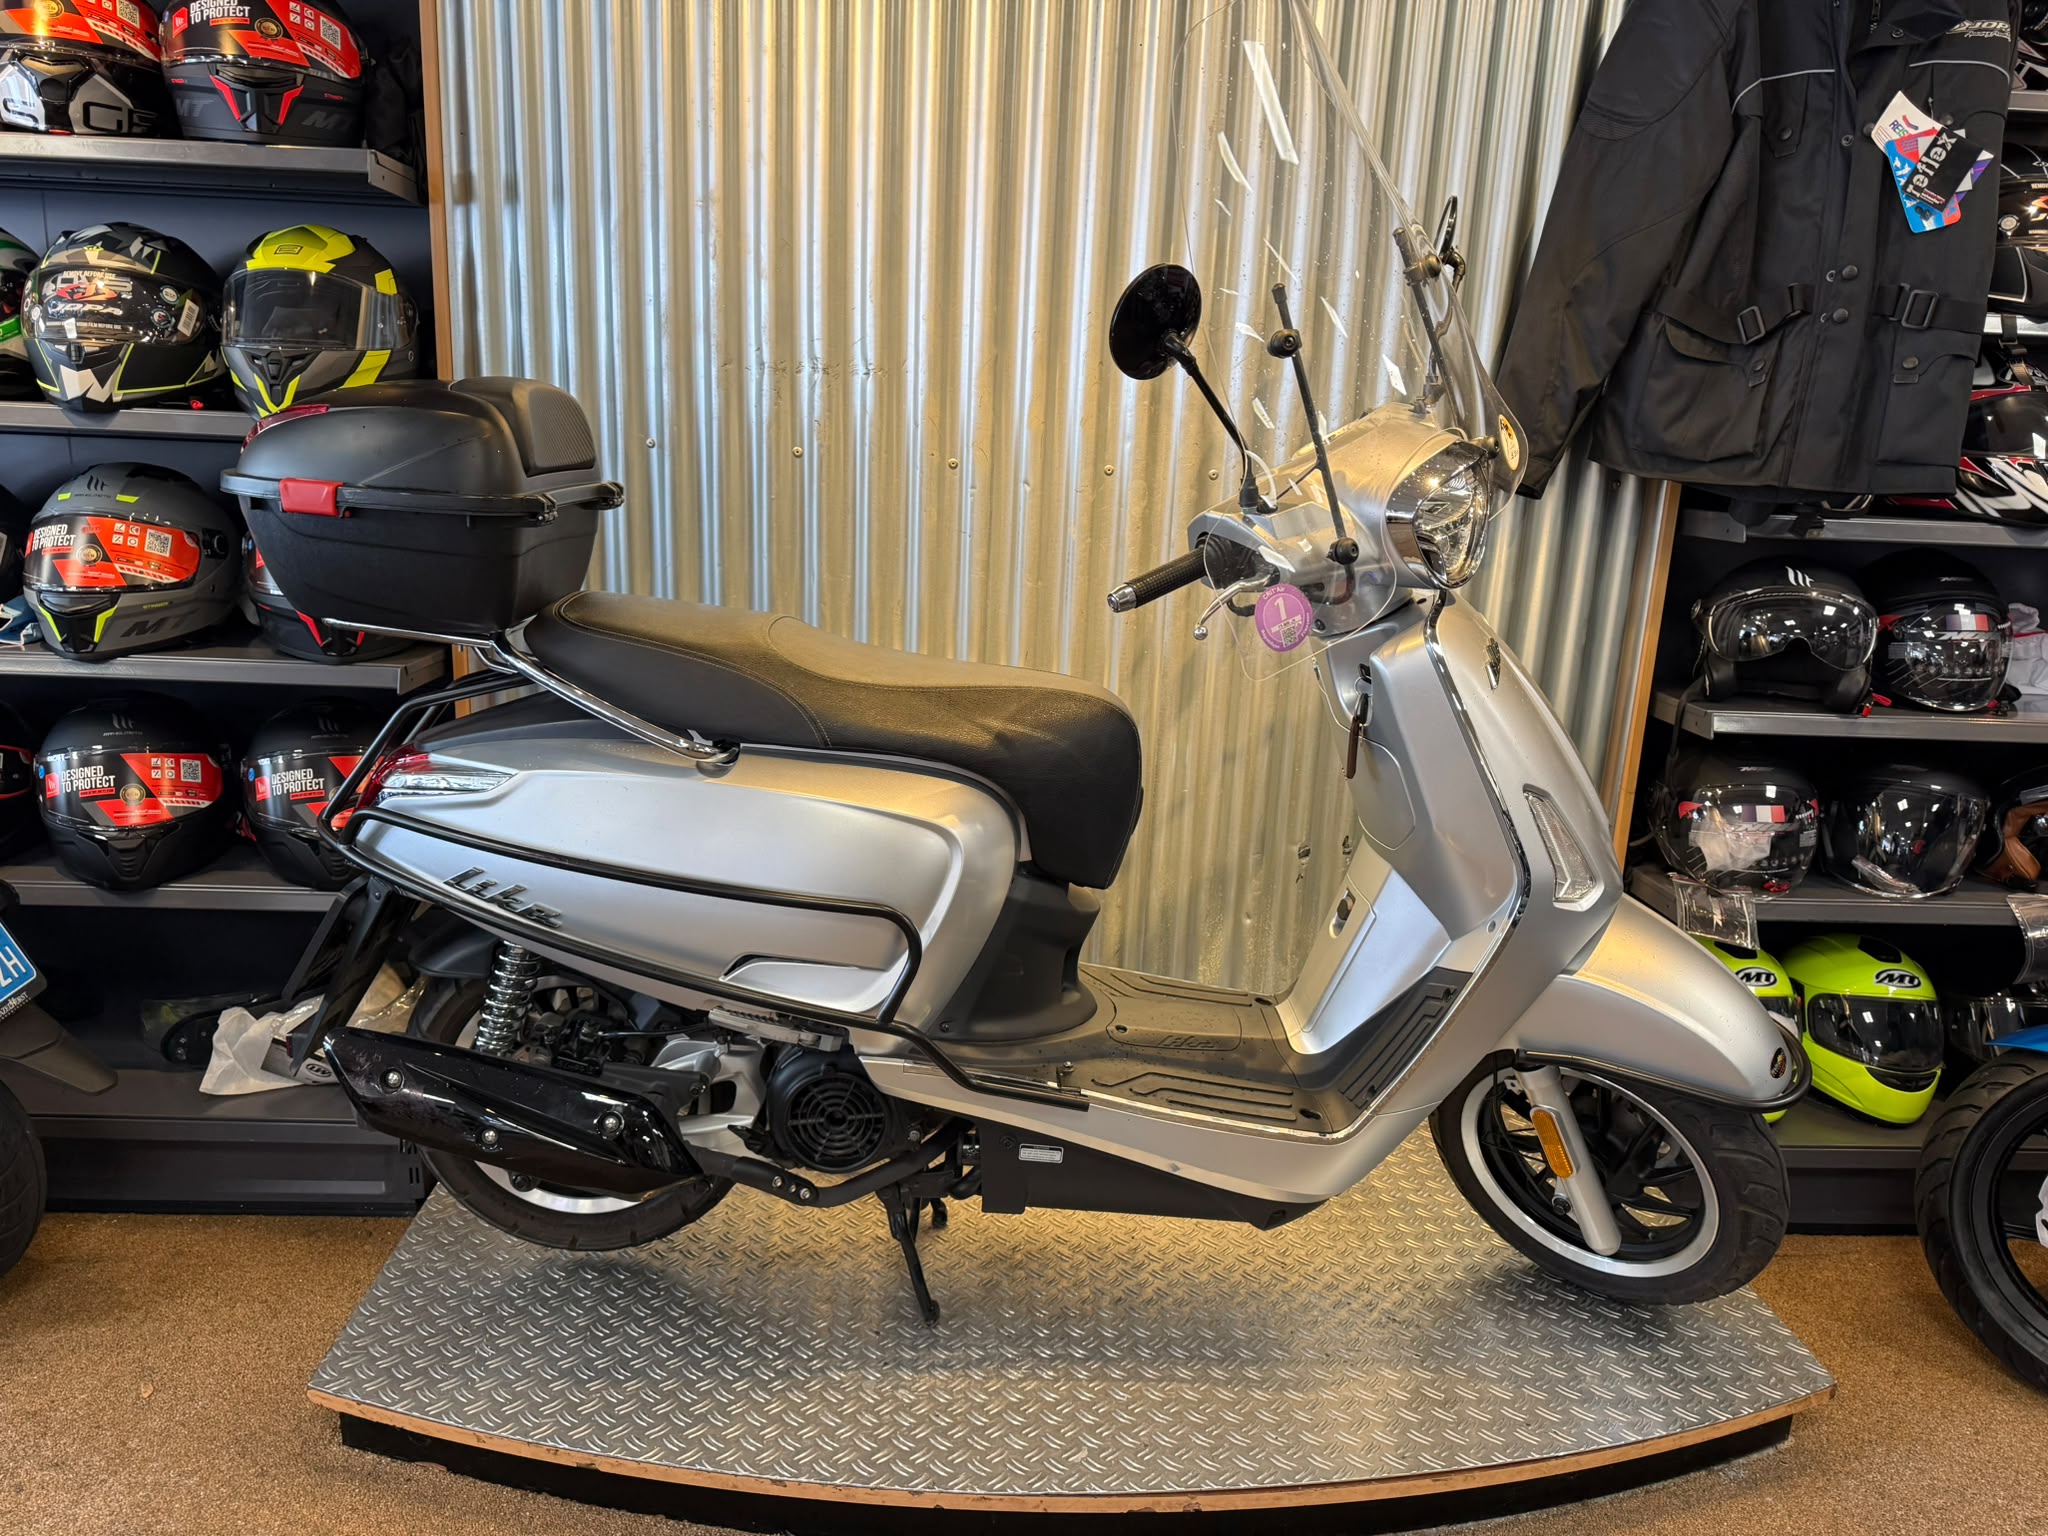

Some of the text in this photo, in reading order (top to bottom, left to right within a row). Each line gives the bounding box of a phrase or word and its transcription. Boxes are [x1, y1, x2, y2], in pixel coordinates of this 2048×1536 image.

[190, 11, 201, 24] TO
[203, 6, 251, 20] PROTECT
[1906, 132, 1958, 198] reflex
[34, 524, 68, 540] DESIGNED
[32, 537, 40, 551] TO
[39, 535, 76, 549] PROTECT
[1274, 597, 1287, 620] 1
[62, 766, 104, 782] DESIGNED
[271, 768, 314, 785] DESIGNED
[62, 781, 71, 793] TO
[73, 776, 115, 791] PROTECT
[272, 785, 282, 796] TO
[284, 778, 325, 794] PROTECT
